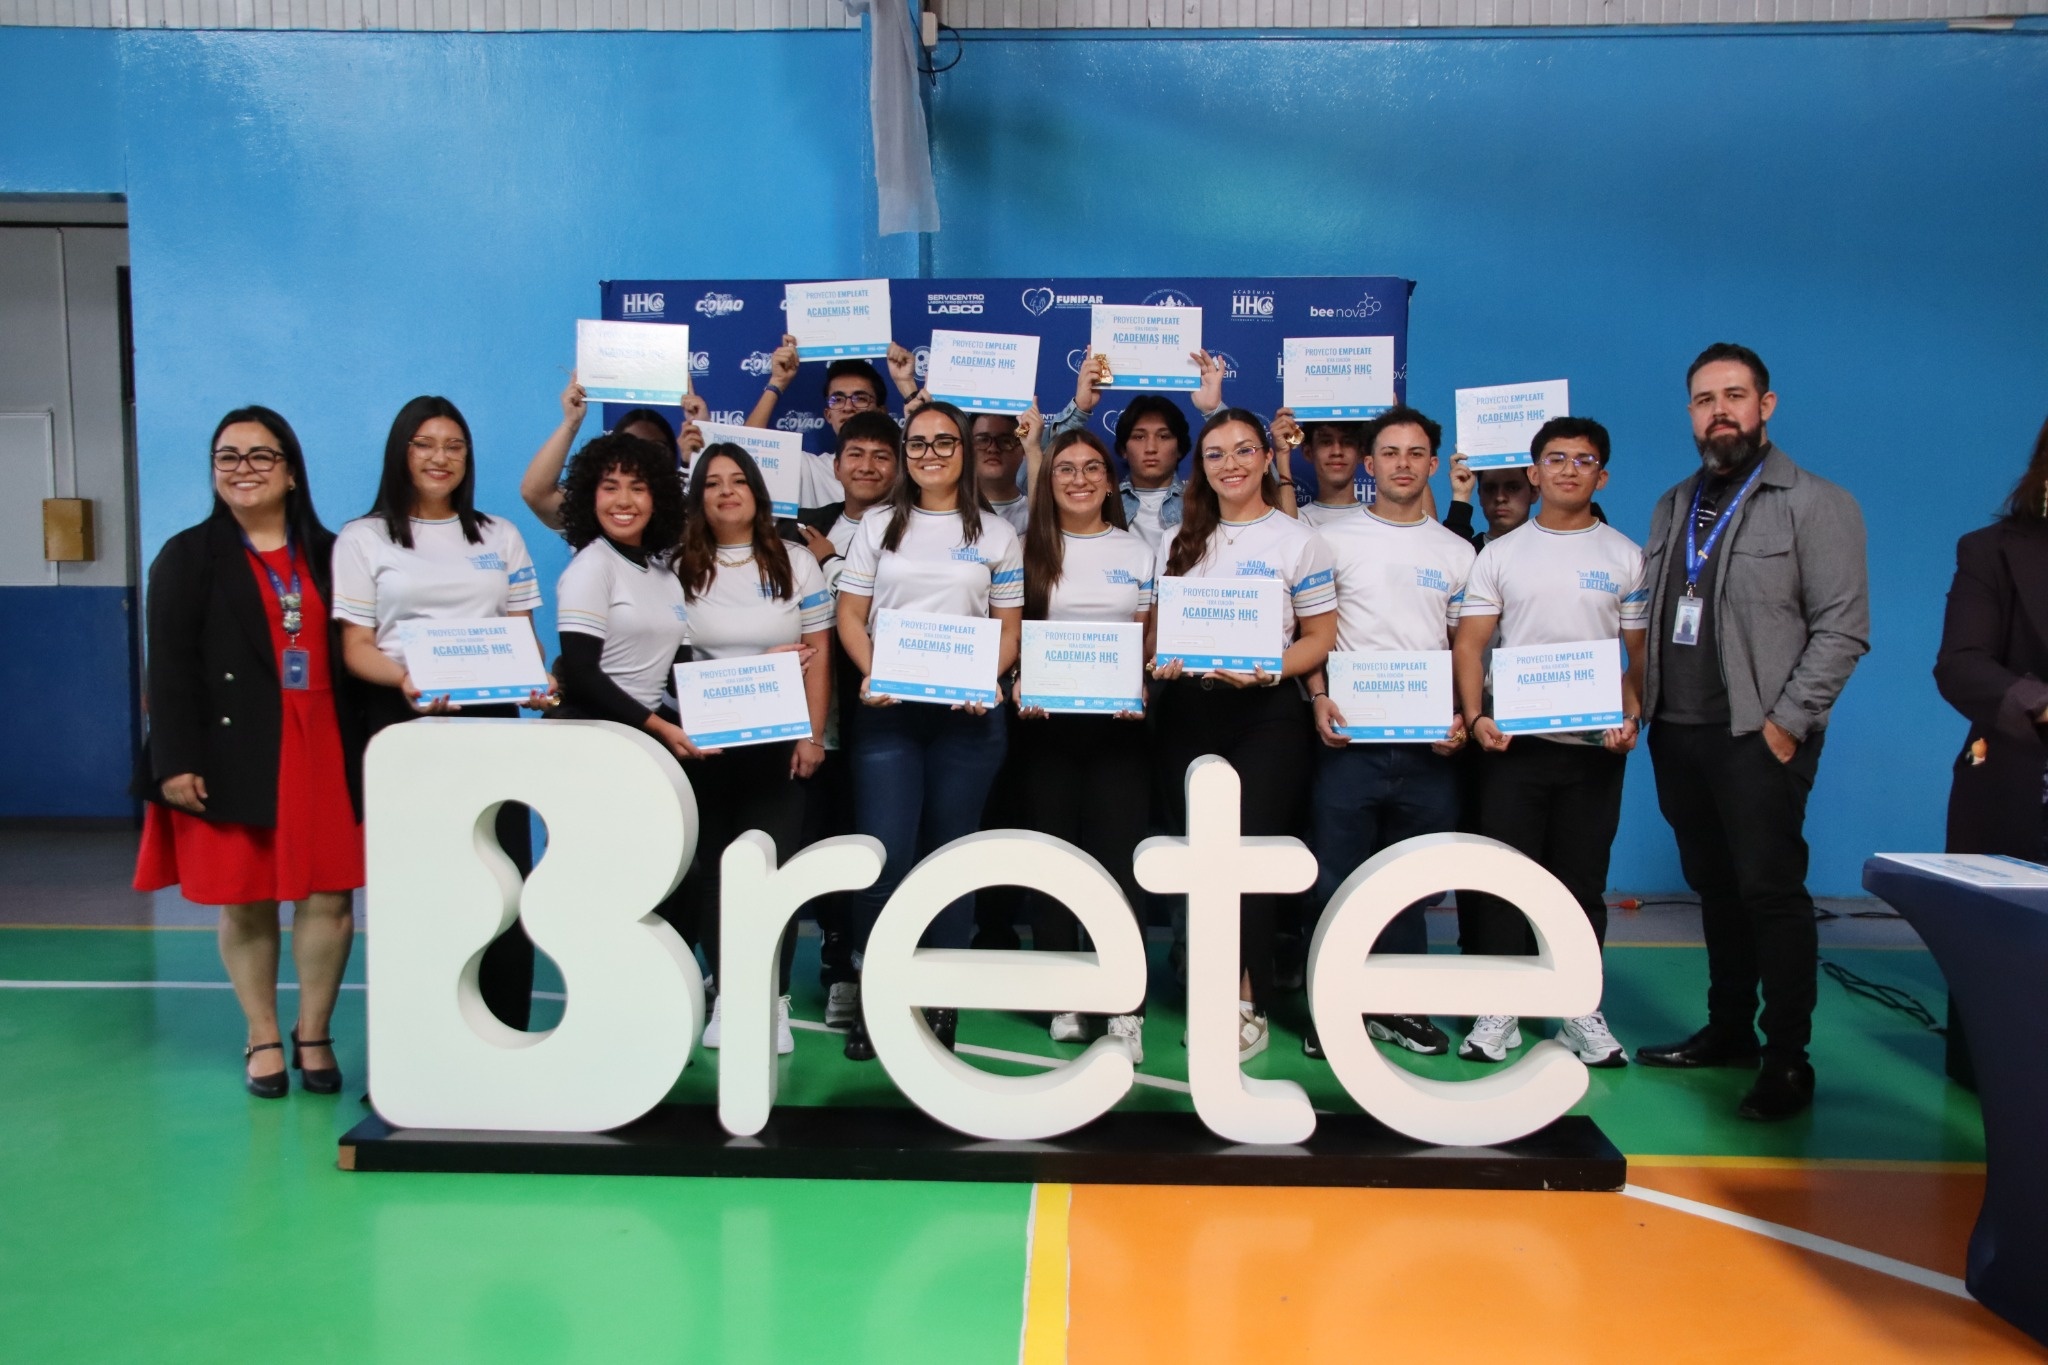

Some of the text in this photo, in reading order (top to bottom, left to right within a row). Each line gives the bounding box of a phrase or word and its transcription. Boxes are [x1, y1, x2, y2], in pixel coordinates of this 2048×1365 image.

[838, 290, 868, 298] EMPLEATE
[1056, 295, 1104, 304] FUNIPAR
[928, 305, 983, 314] LABCO
[1232, 295, 1274, 315] HHC
[807, 306, 870, 317] ACADEMIAS HHC
[1114, 316, 1180, 325] PROYECTO EMPLEATE
[1113, 333, 1180, 344] ACADEMIAS HHC
[952, 339, 1017, 351] PROYECTO EMPLEATE
[1305, 347, 1372, 356] PROYECTO EMPLEATE
[951, 356, 1016, 369] ACADEMIAS HHC
[1305, 364, 1372, 375] ACADEMIAS HHC
[1477, 393, 1544, 405] PROYECTO EMPLEATE
[1477, 410, 1544, 424] ACADEMIAS HHC
[762, 457, 779, 470] HHC
[1247, 560, 1266, 568] NADA
[1426, 569, 1442, 578] NADA
[1590, 570, 1609, 580] NADA
[1183, 588, 1258, 599] PROYECTO EMPLEATE
[1183, 607, 1258, 621] ACADEMIAS HHC
[468, 627, 507, 636] EMPLEATE
[901, 620, 976, 634] PROYECTO EMPLEATE
[1045, 632, 1118, 642] PROYECTO EMPLEATE
[433, 644, 512, 656] ACADEMIAS HHC
[899, 638, 974, 655] ACADEMIAS HHC
[1045, 650, 1118, 663] ACADEMIAS HHC
[1517, 651, 1593, 664] PROYECTO EMPLEATE
[700, 664, 775, 679] PROYECTO EMPLEATE
[1353, 663, 1388, 671] PROYECTO
[1518, 669, 1594, 684] ACADEMIAS HHC
[703, 681, 780, 699] ACADEMIAS HHC
[1353, 680, 1428, 692] ACADEMIAS HHC
[364, 716, 1603, 1147] Brete
